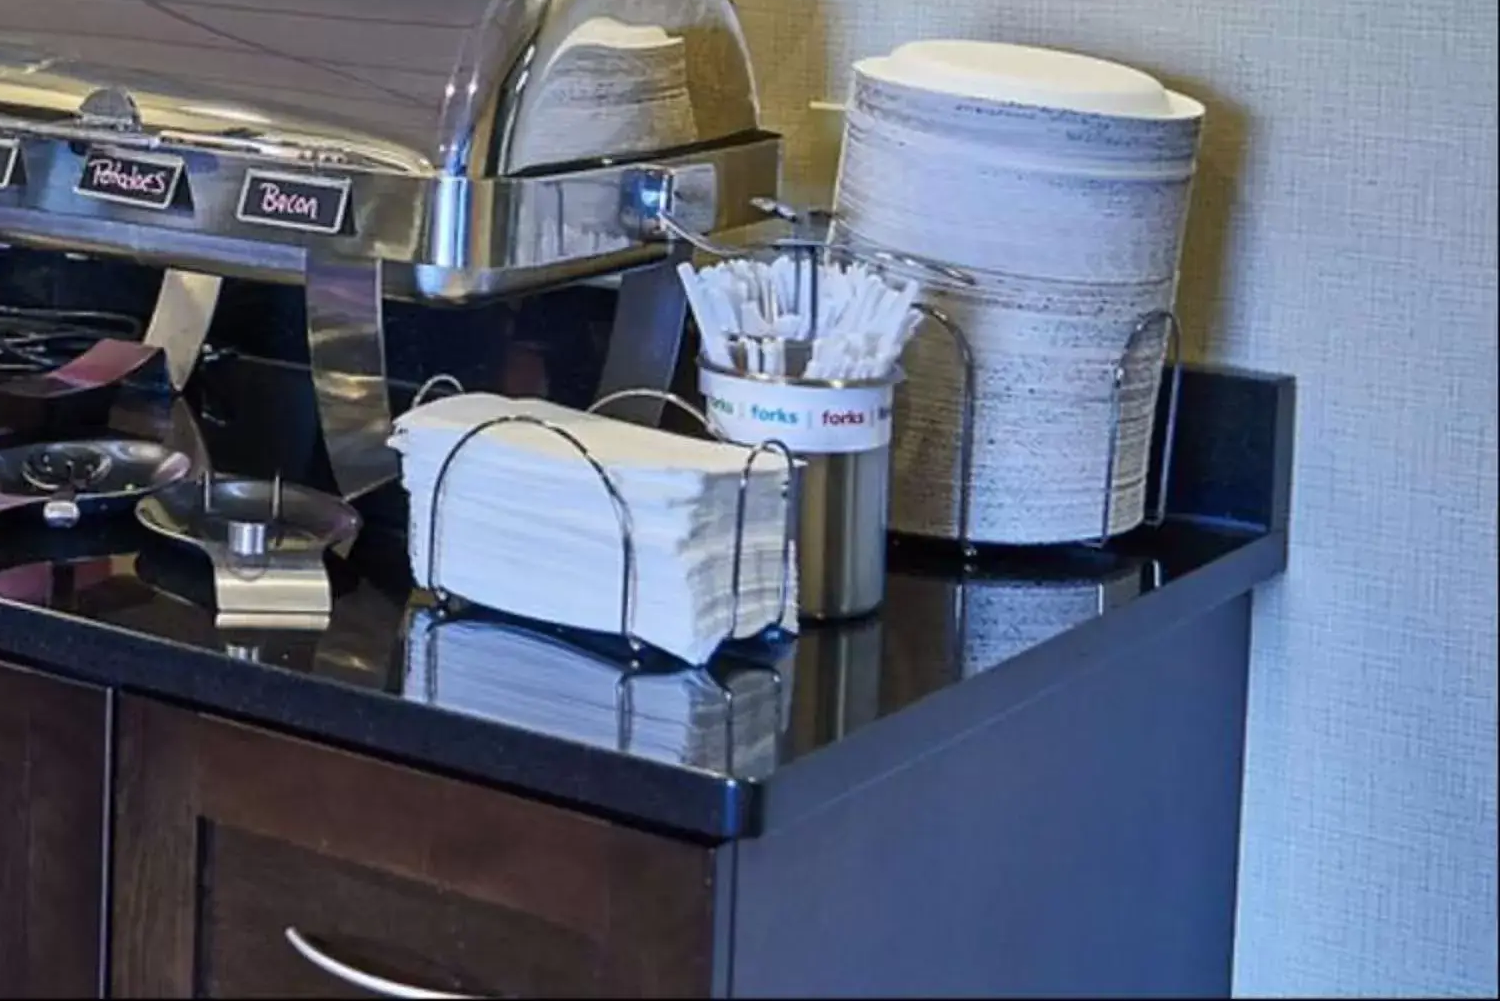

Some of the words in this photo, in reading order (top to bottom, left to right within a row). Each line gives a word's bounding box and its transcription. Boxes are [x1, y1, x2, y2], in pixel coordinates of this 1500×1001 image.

[88, 159, 167, 194] Potatoes
[259, 182, 318, 219] Bacon
[751, 404, 798, 424] forks
[822, 409, 864, 426] forks
